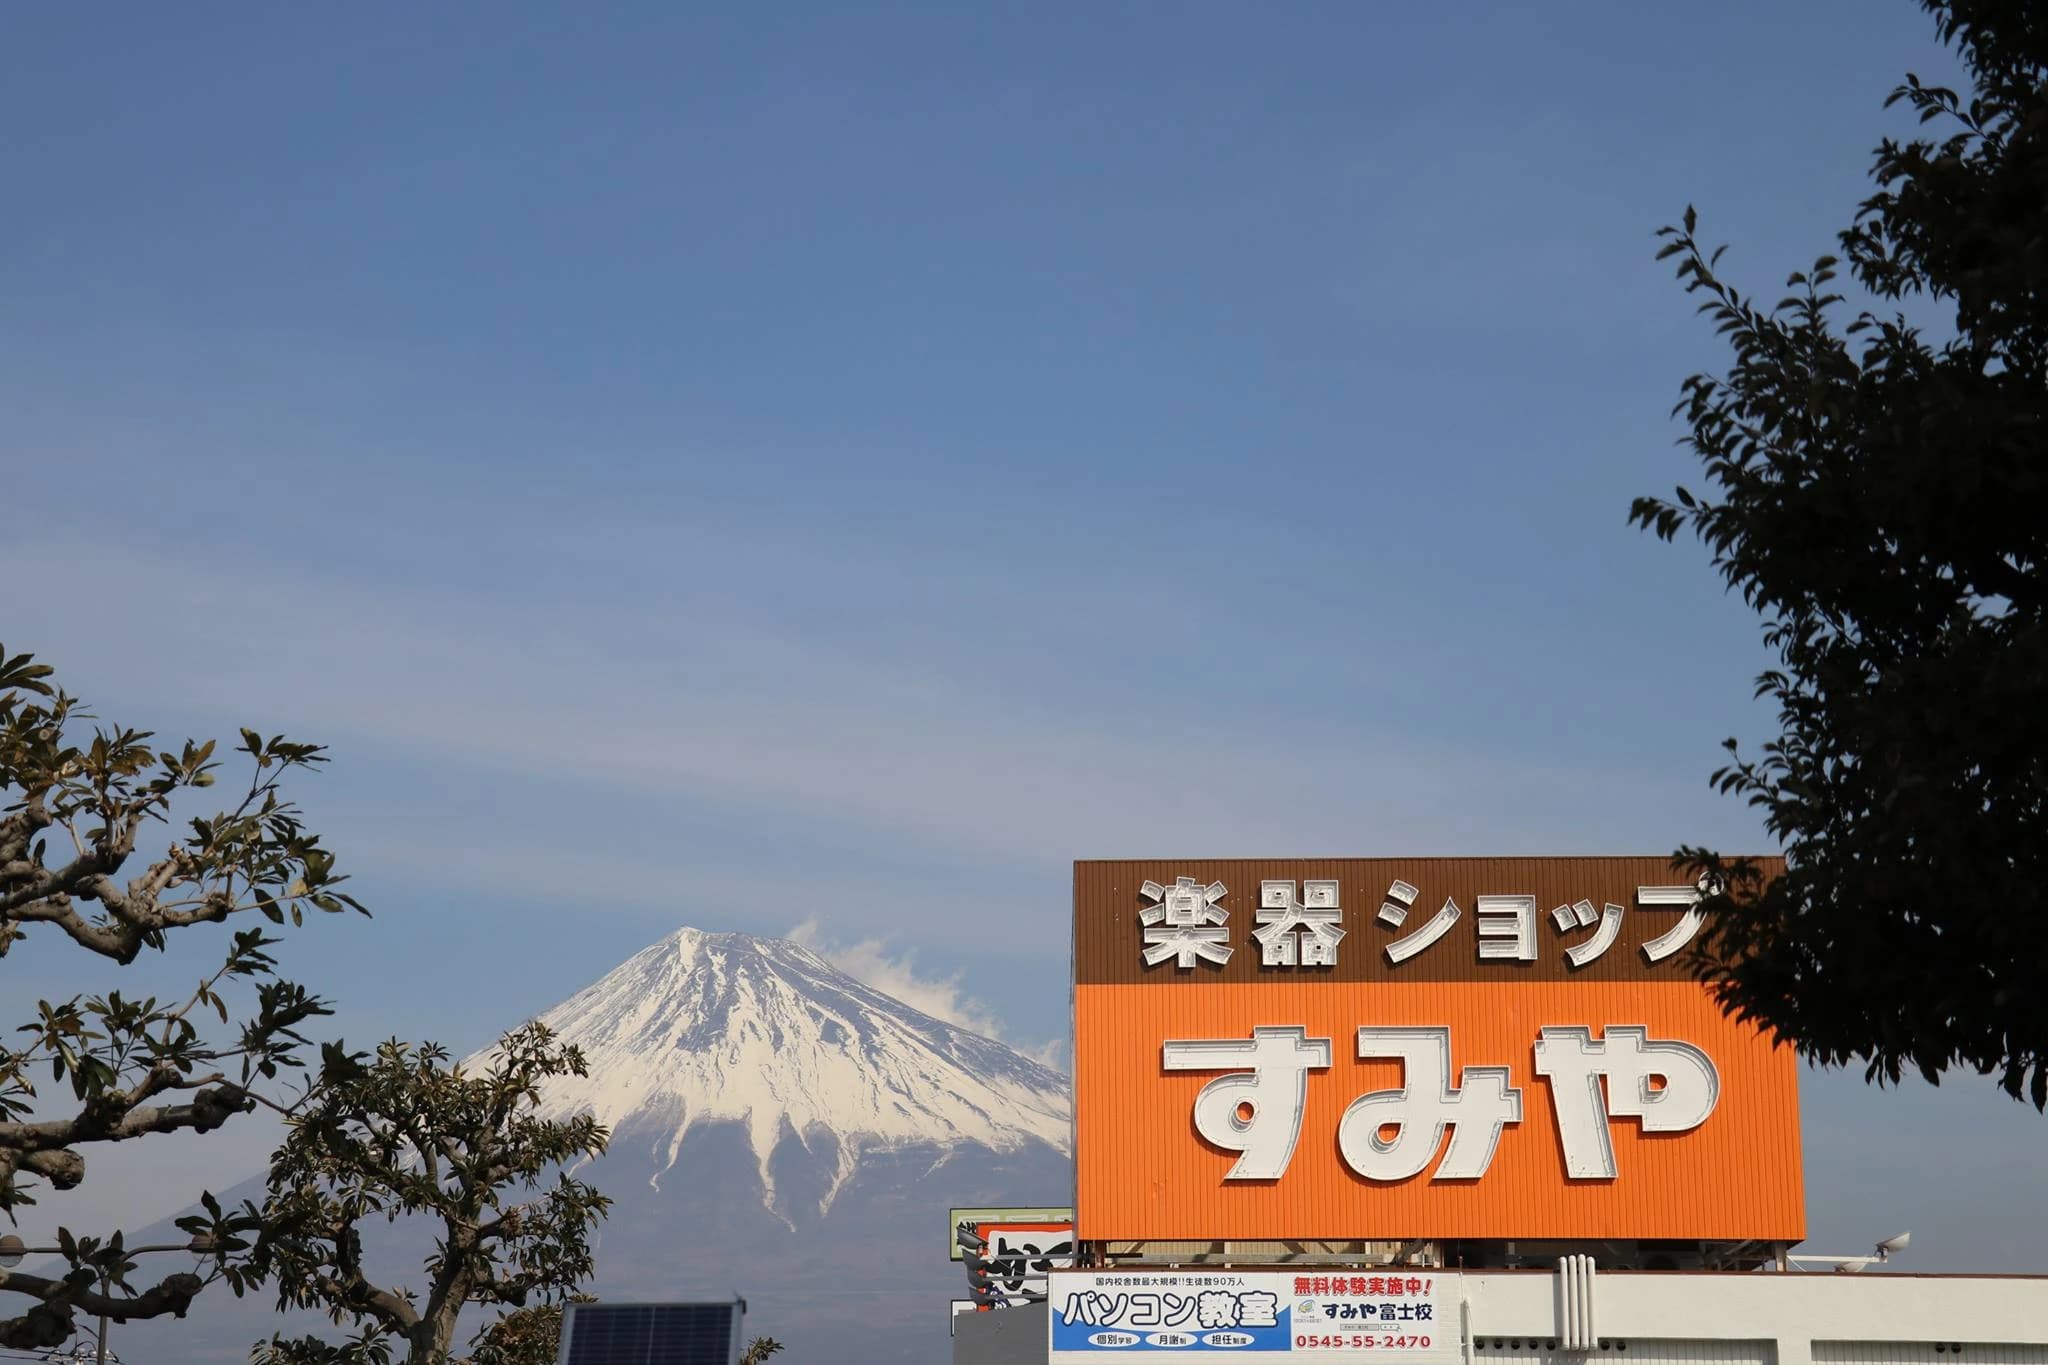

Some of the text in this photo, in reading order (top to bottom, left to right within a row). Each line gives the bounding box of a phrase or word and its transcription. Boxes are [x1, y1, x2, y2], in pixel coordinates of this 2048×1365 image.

[1139, 871, 1725, 968] 楽器ショップ
[1162, 1024, 1720, 1181] すみや
[1095, 1277, 1245, 1287] 国内校舎数最大規模!!生徒数90万人
[1294, 1276, 1432, 1297] 無料体験実施中!
[1062, 1289, 1278, 1328] パソコン教室
[1096, 1334, 1132, 1345] 個別学習
[1296, 1335, 1432, 1348] 0545-55-2470
